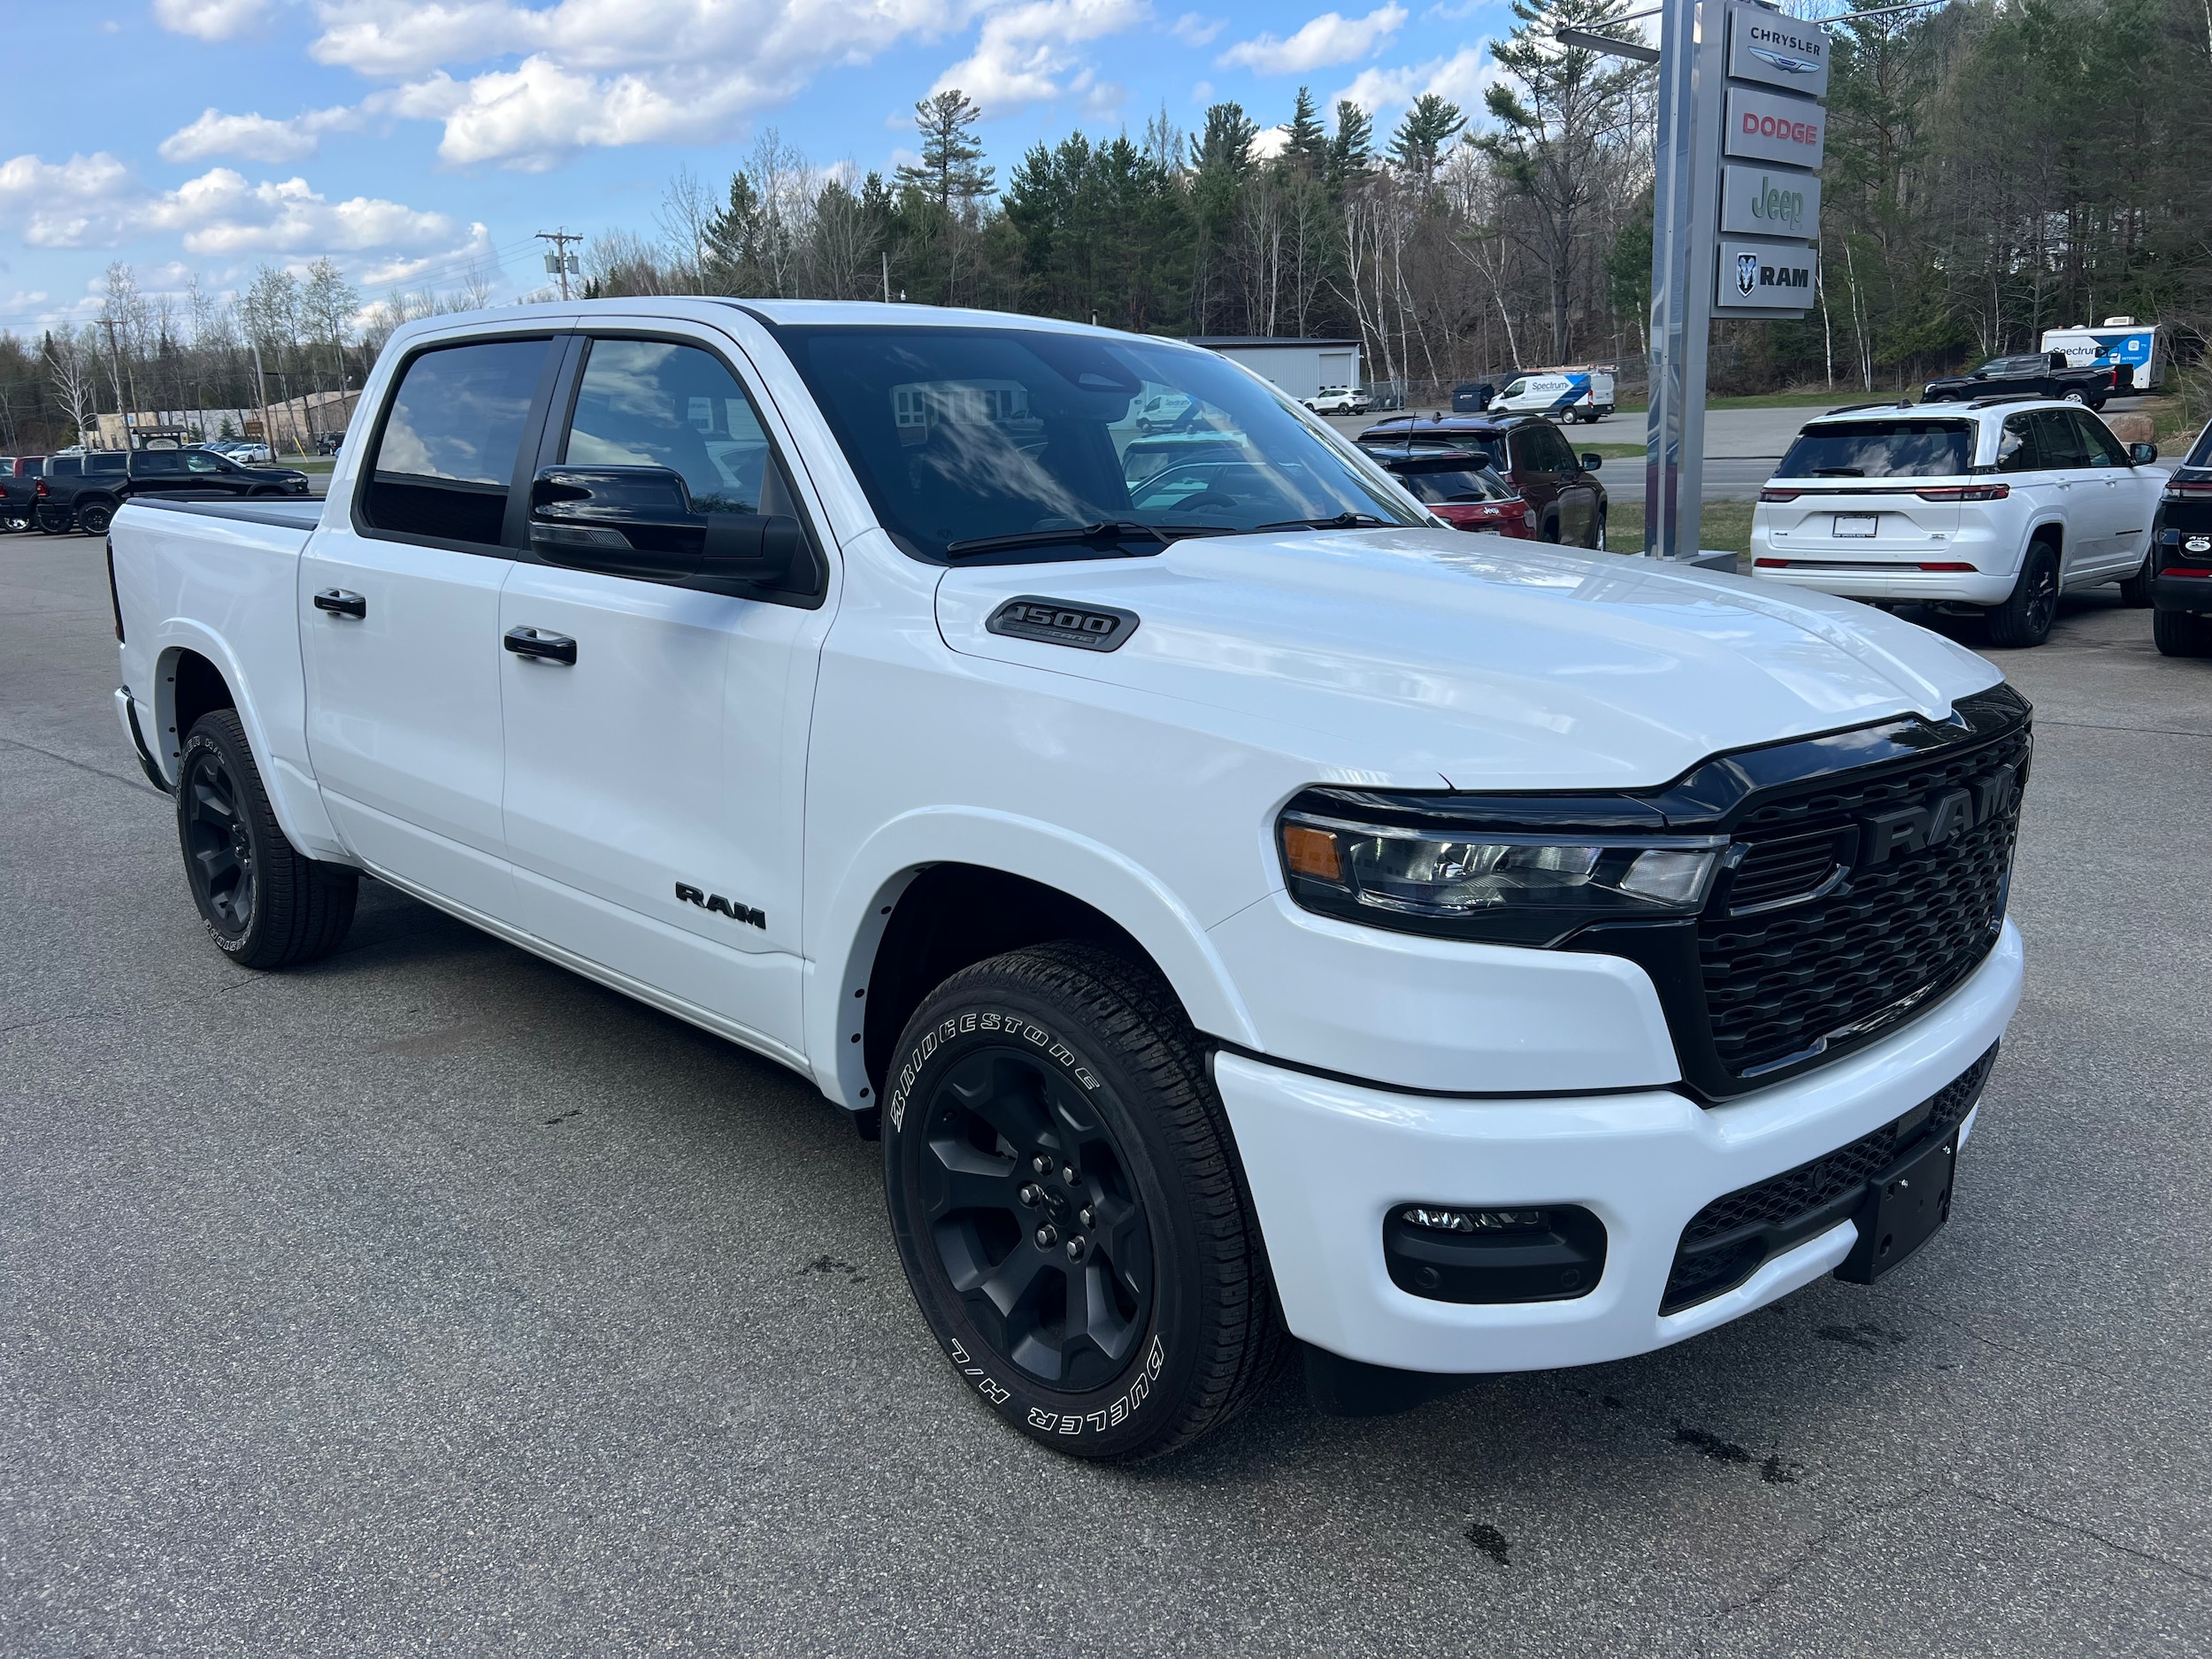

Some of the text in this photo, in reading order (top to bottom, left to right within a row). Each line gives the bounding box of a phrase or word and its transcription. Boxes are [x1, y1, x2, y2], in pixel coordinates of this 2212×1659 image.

[1750, 27, 1820, 57] CHRYSLER
[1743, 112, 1818, 146] DODGE
[1752, 176, 1804, 230] Jeep
[1760, 266, 1809, 288] RAM
[1532, 381, 1566, 391] Spectrum
[1002, 605, 1113, 634] 1500
[1863, 764, 2014, 865] RAM
[675, 881, 766, 930] RAM
[890, 1012, 1101, 1133] BRIDGESTONE
[951, 1334, 1165, 1435] DUELER H/L
